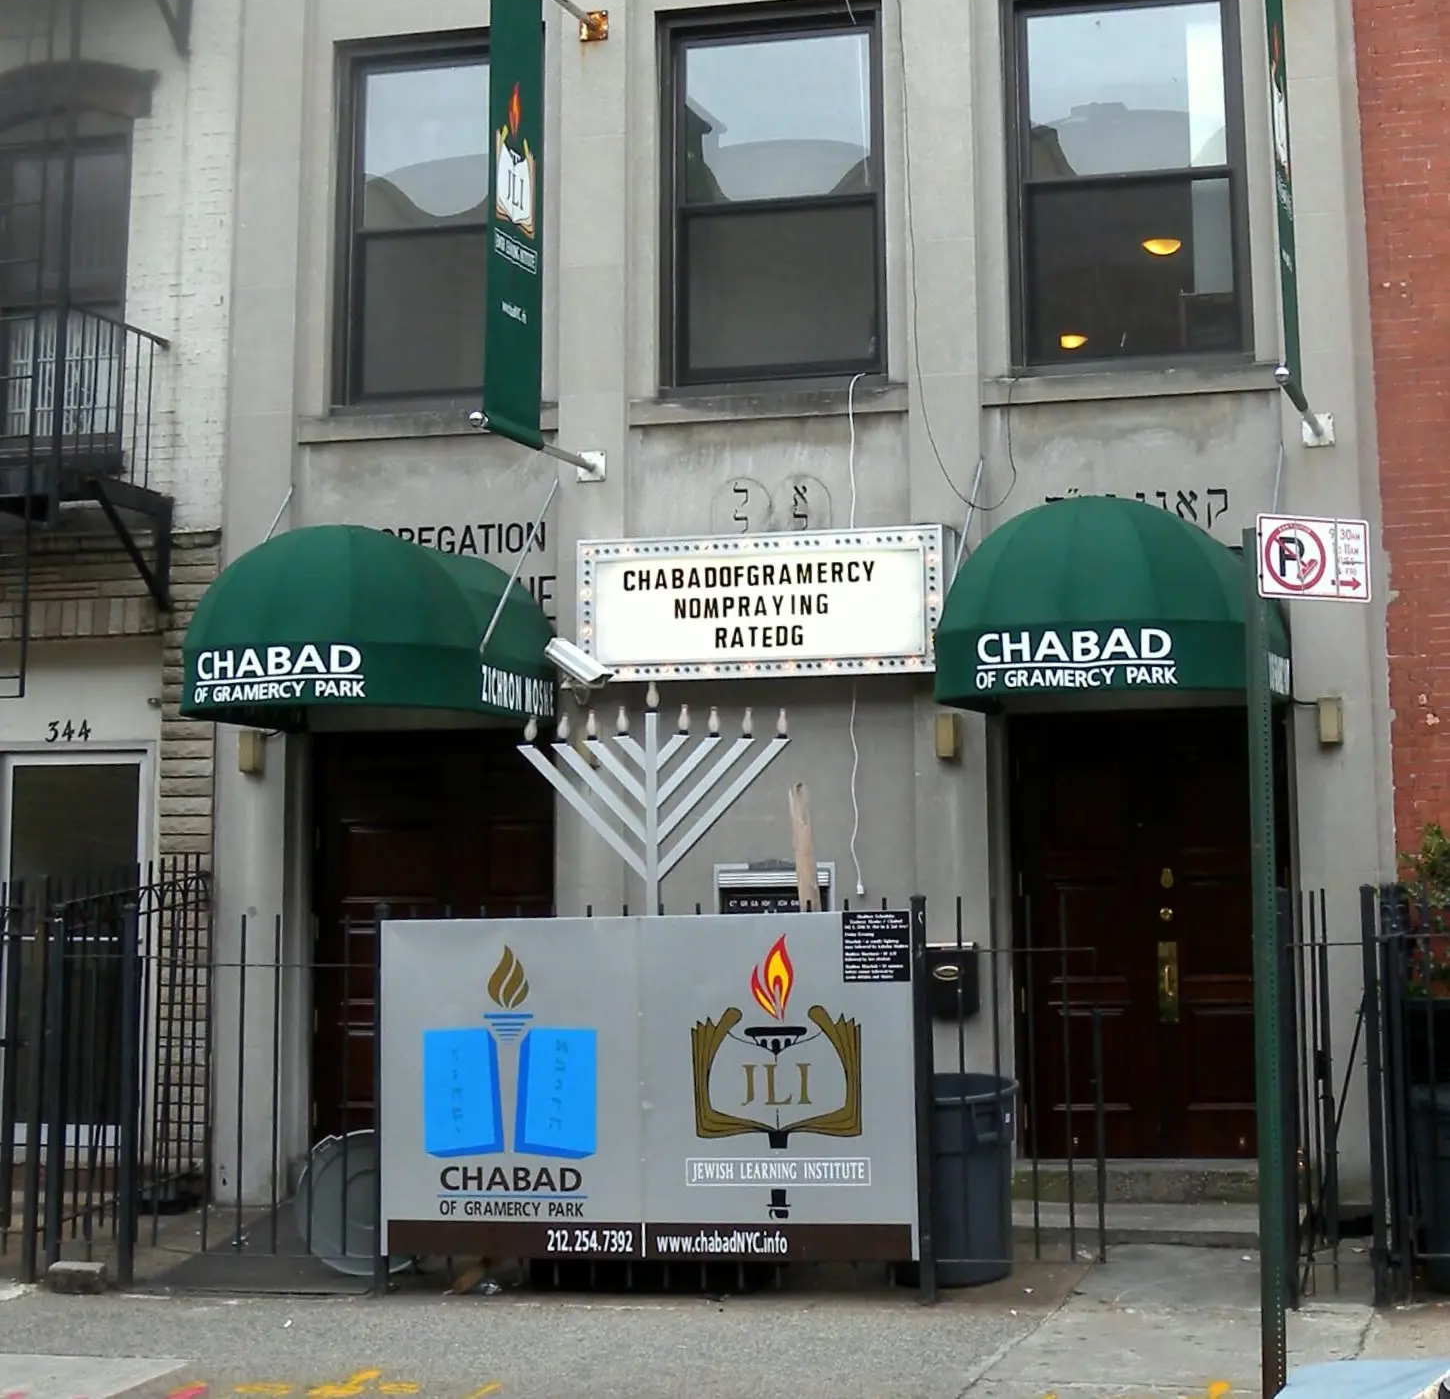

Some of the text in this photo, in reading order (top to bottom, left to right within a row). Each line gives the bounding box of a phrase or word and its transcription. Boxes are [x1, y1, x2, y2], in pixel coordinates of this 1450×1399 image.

[506, 169, 524, 211] JLI
[976, 628, 1173, 664] CHABAD
[196, 644, 362, 680] CHABAD
[481, 664, 522, 711] ZICHRON
[975, 666, 1179, 690] OF GRAMERCY PARK
[194, 680, 366, 703] OF GRAMERCY PARK
[45, 719, 91, 743] 344
[741, 1063, 812, 1107] JLI
[439, 1165, 582, 1192] CHABAD
[691, 1161, 866, 1182] JEWISH LEARNING INSTITUTE
[439, 1199, 585, 1218] OF GRAMERCY PARK
[546, 1229, 788, 1254] 212.254.7392 www.chabadNYC.info
